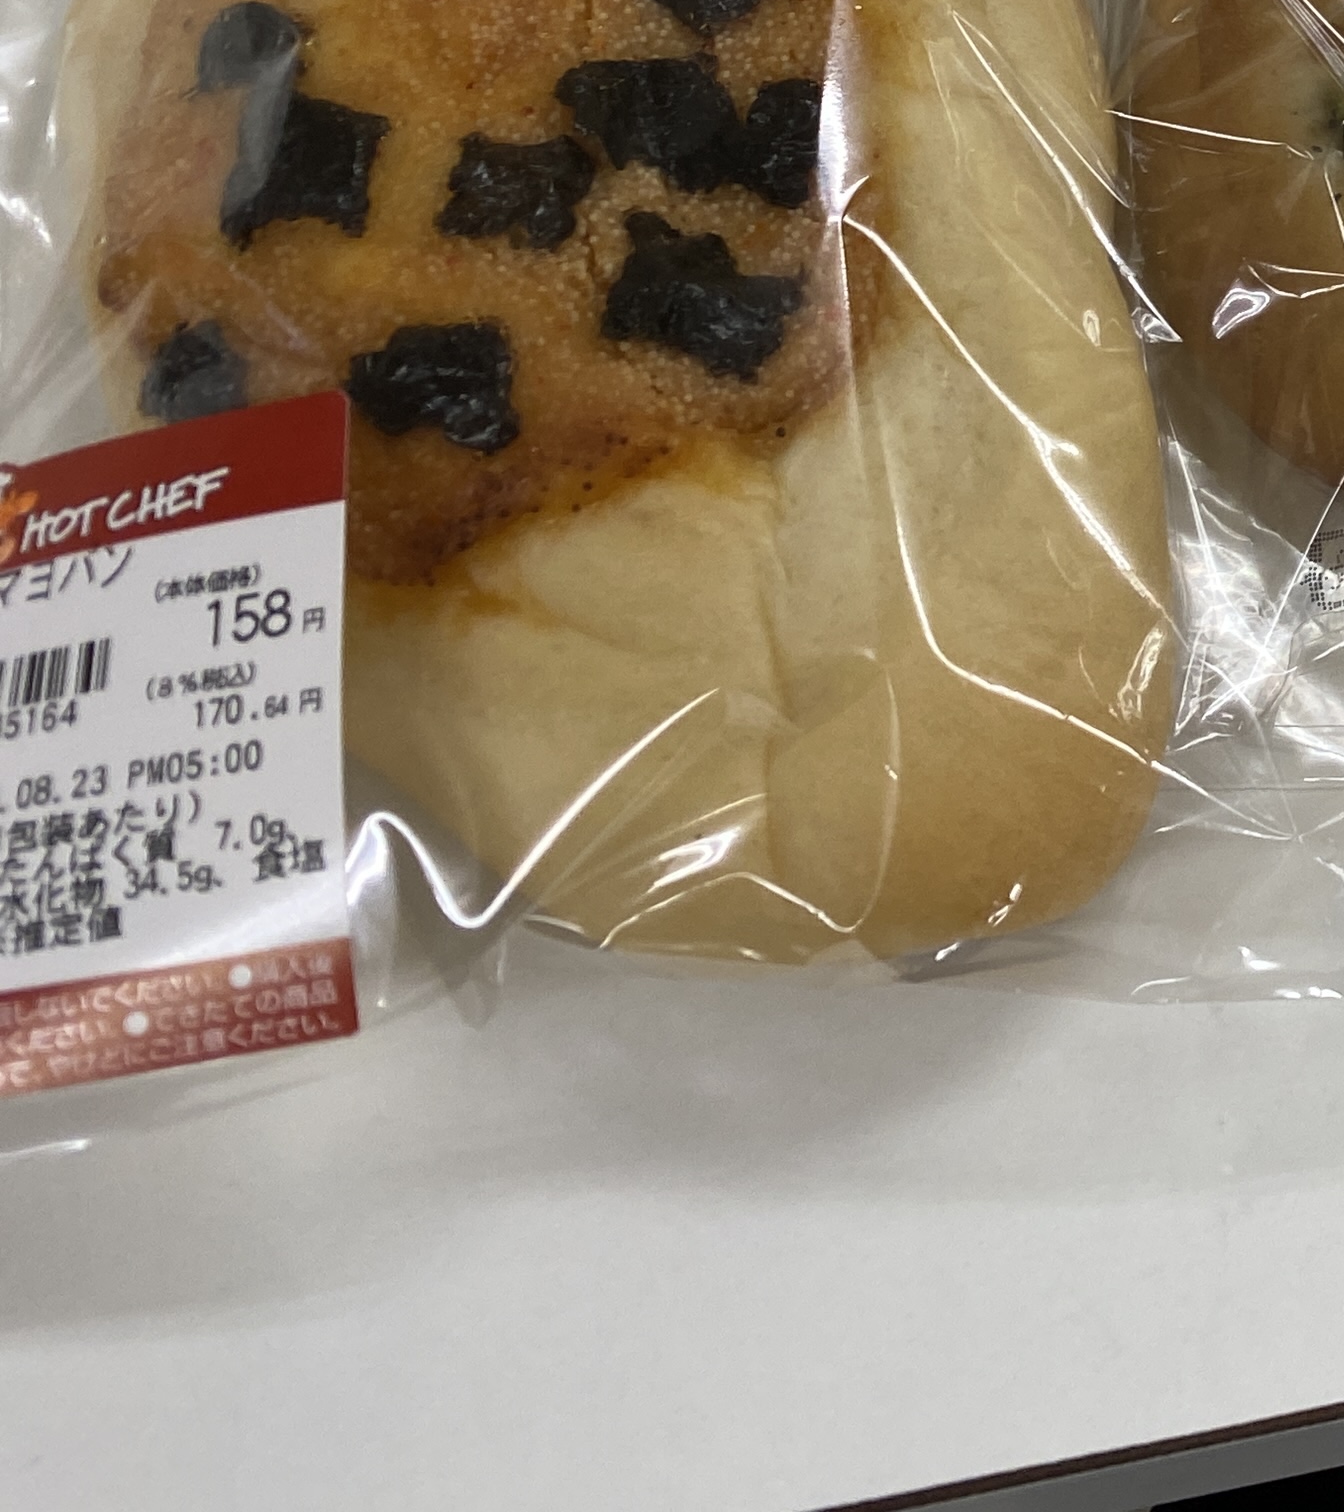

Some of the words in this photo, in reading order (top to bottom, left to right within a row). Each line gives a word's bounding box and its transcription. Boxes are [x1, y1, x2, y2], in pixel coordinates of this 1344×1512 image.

[20, 497, 110, 553] HOT
[105, 465, 231, 532] CHEF
[206, 588, 292, 647] 158
[302, 606, 326, 634] 円
[0, 699, 78, 739] 5164
[194, 694, 290, 730] 170.64
[299, 686, 324, 713] 円
[127, 739, 264, 788] PM05:00
[0, 906, 121, 955] 推定値
